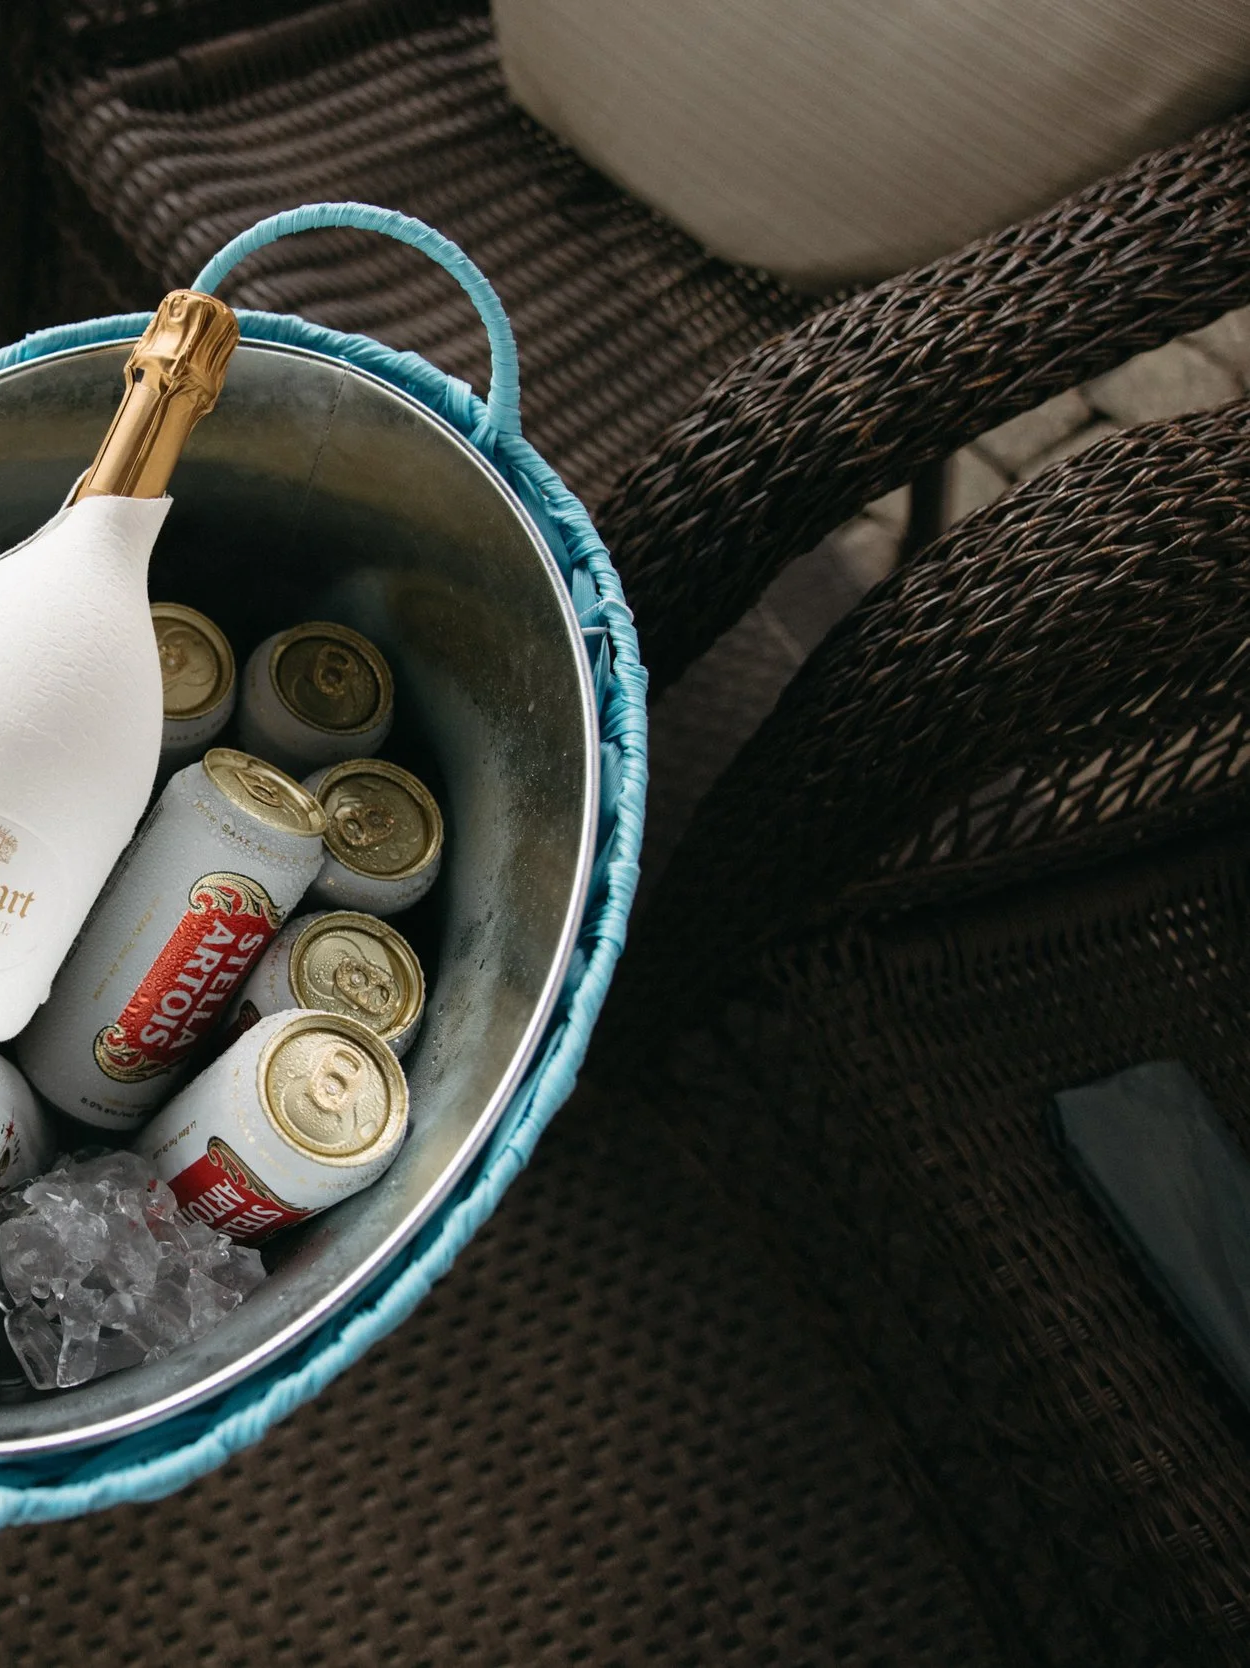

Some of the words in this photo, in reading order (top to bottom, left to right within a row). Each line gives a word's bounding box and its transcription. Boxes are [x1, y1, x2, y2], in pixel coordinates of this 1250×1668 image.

[138, 918, 237, 1049] ARTOIS
[168, 931, 265, 1050] STELLA
[175, 1178, 247, 1227] ARTOI
[215, 1204, 284, 1239] STELL
